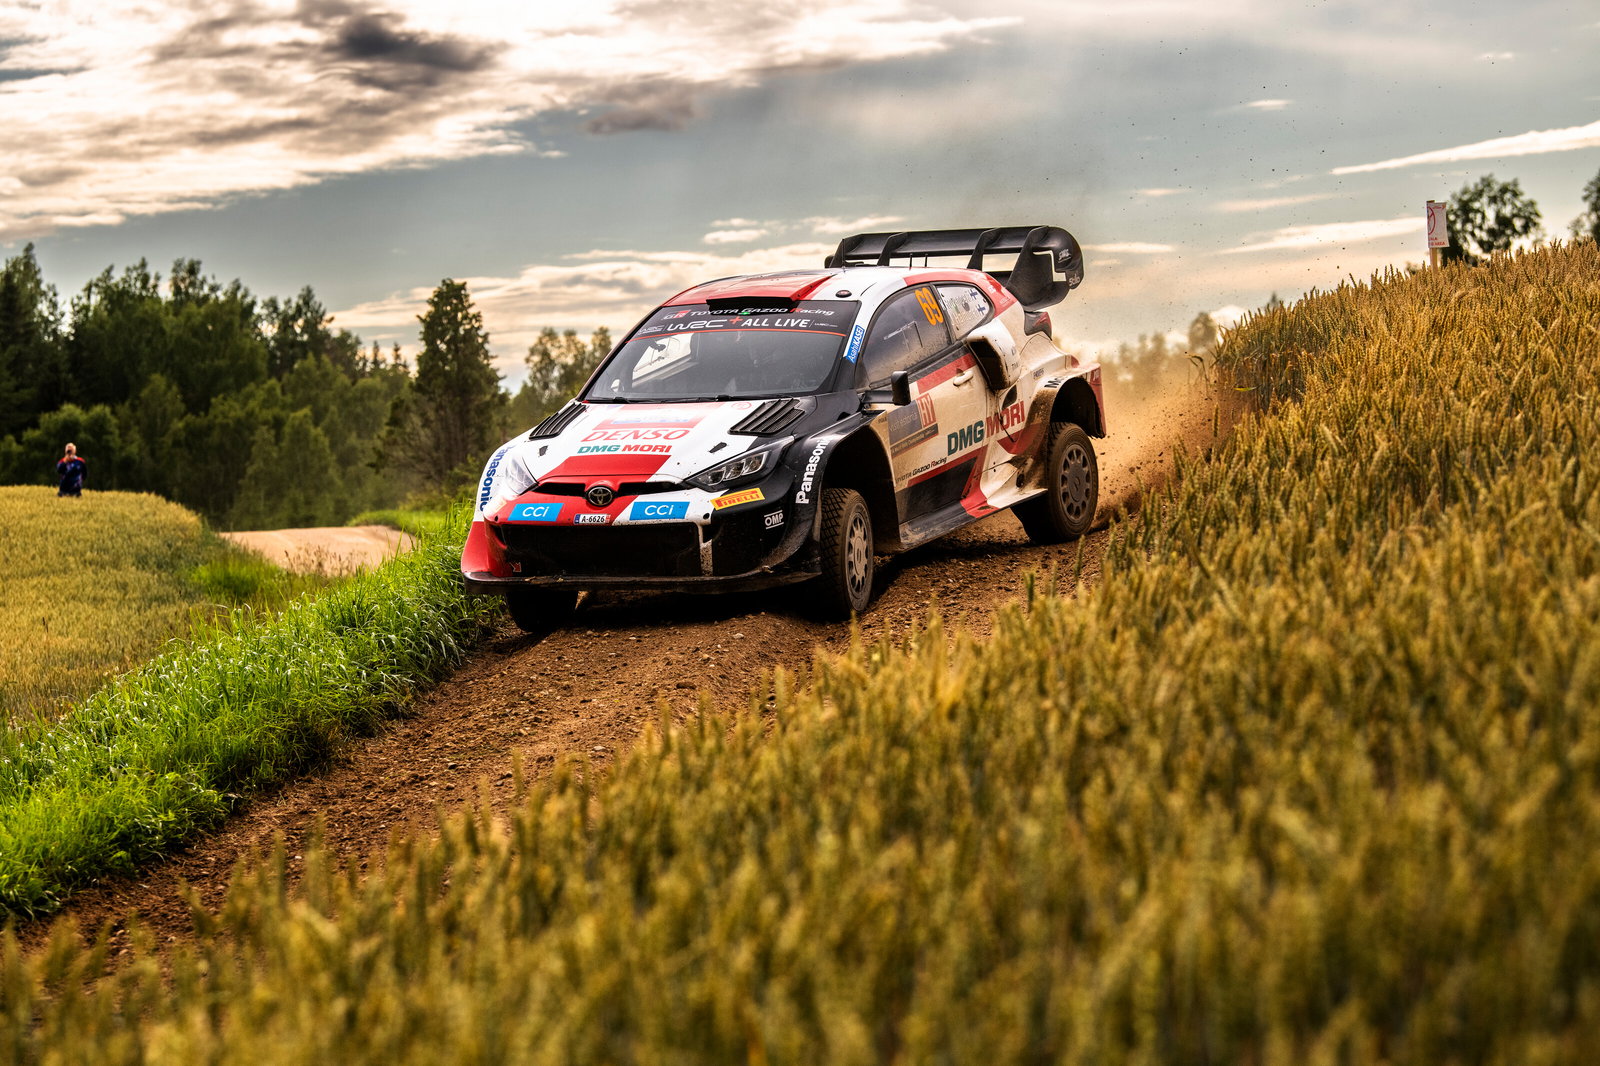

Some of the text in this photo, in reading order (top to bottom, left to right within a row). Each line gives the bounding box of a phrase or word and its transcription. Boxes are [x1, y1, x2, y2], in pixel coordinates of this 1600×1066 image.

[690, 308, 739, 317] TOYOTA
[790, 307, 835, 316] Racing
[915, 287, 943, 326] 69
[741, 318, 770, 328] ALL
[774, 318, 811, 328] LIVE
[580, 429, 690, 442] DENSO
[947, 419, 985, 457] DMG
[985, 400, 1026, 439] MORI
[577, 444, 673, 454] DMG MORI
[795, 439, 831, 504] Panasoni
[714, 490, 760, 508] PIRELLI
[581, 515, 605, 523] A-6626
[765, 512, 784, 527] OMP
